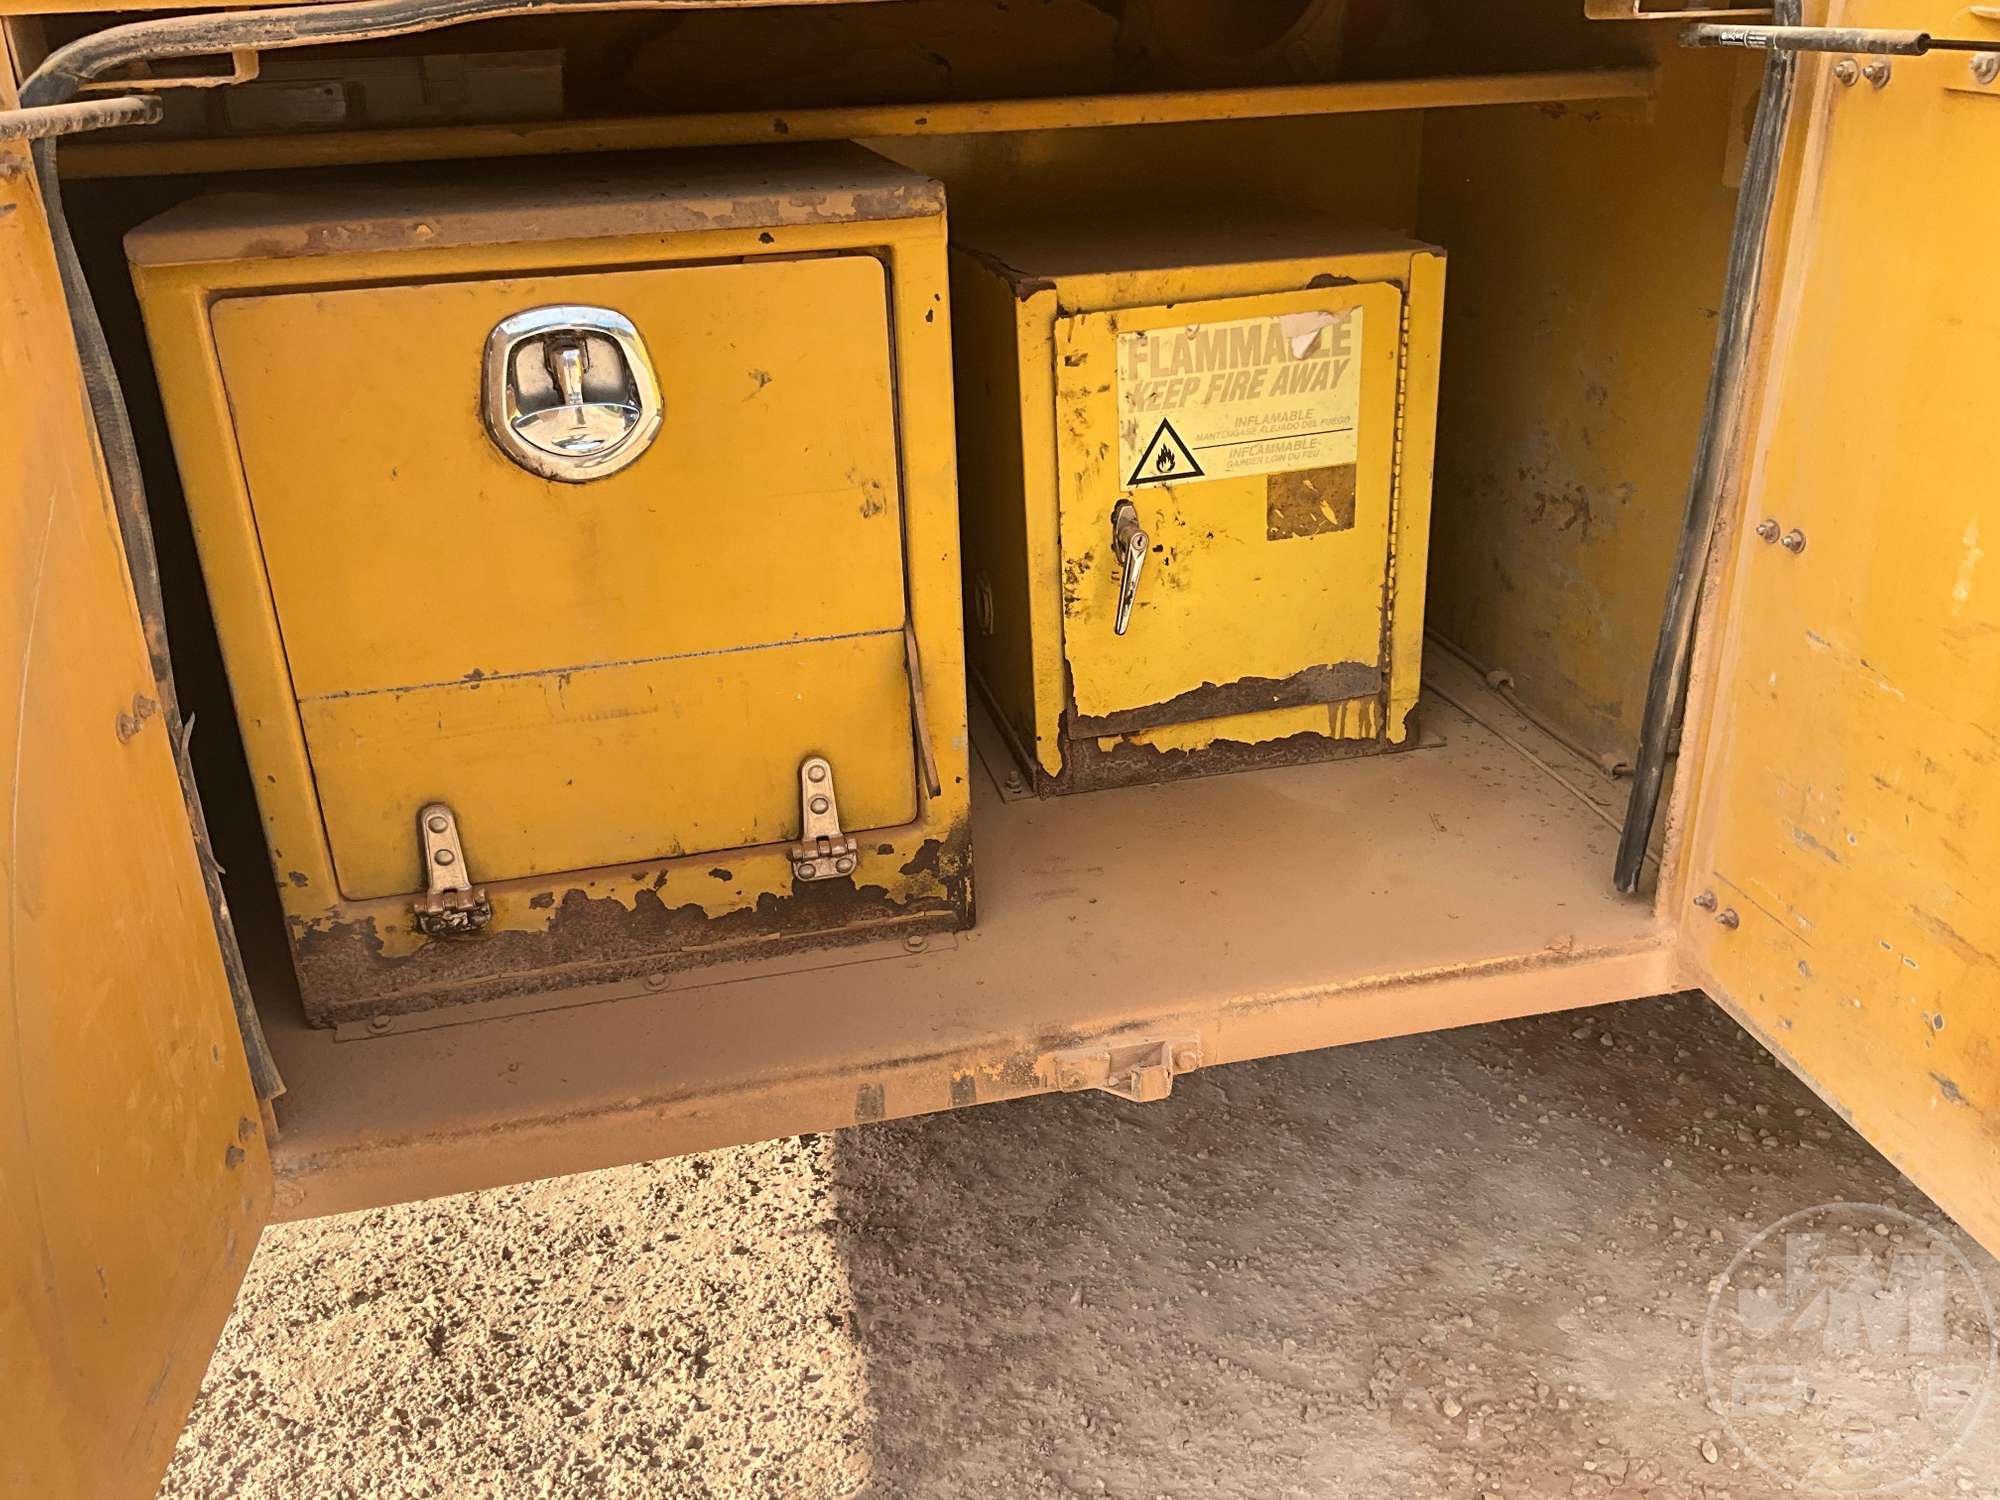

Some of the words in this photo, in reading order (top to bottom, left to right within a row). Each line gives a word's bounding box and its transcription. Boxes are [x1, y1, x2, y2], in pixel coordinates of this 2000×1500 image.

[1128, 320, 1351, 381] FLAMMALE
[1128, 377, 1200, 414] KEEP
[1203, 368, 1267, 405] FIRE
[1269, 358, 1350, 397] AWAY
[1234, 408, 1315, 428] INFLAMABLE
